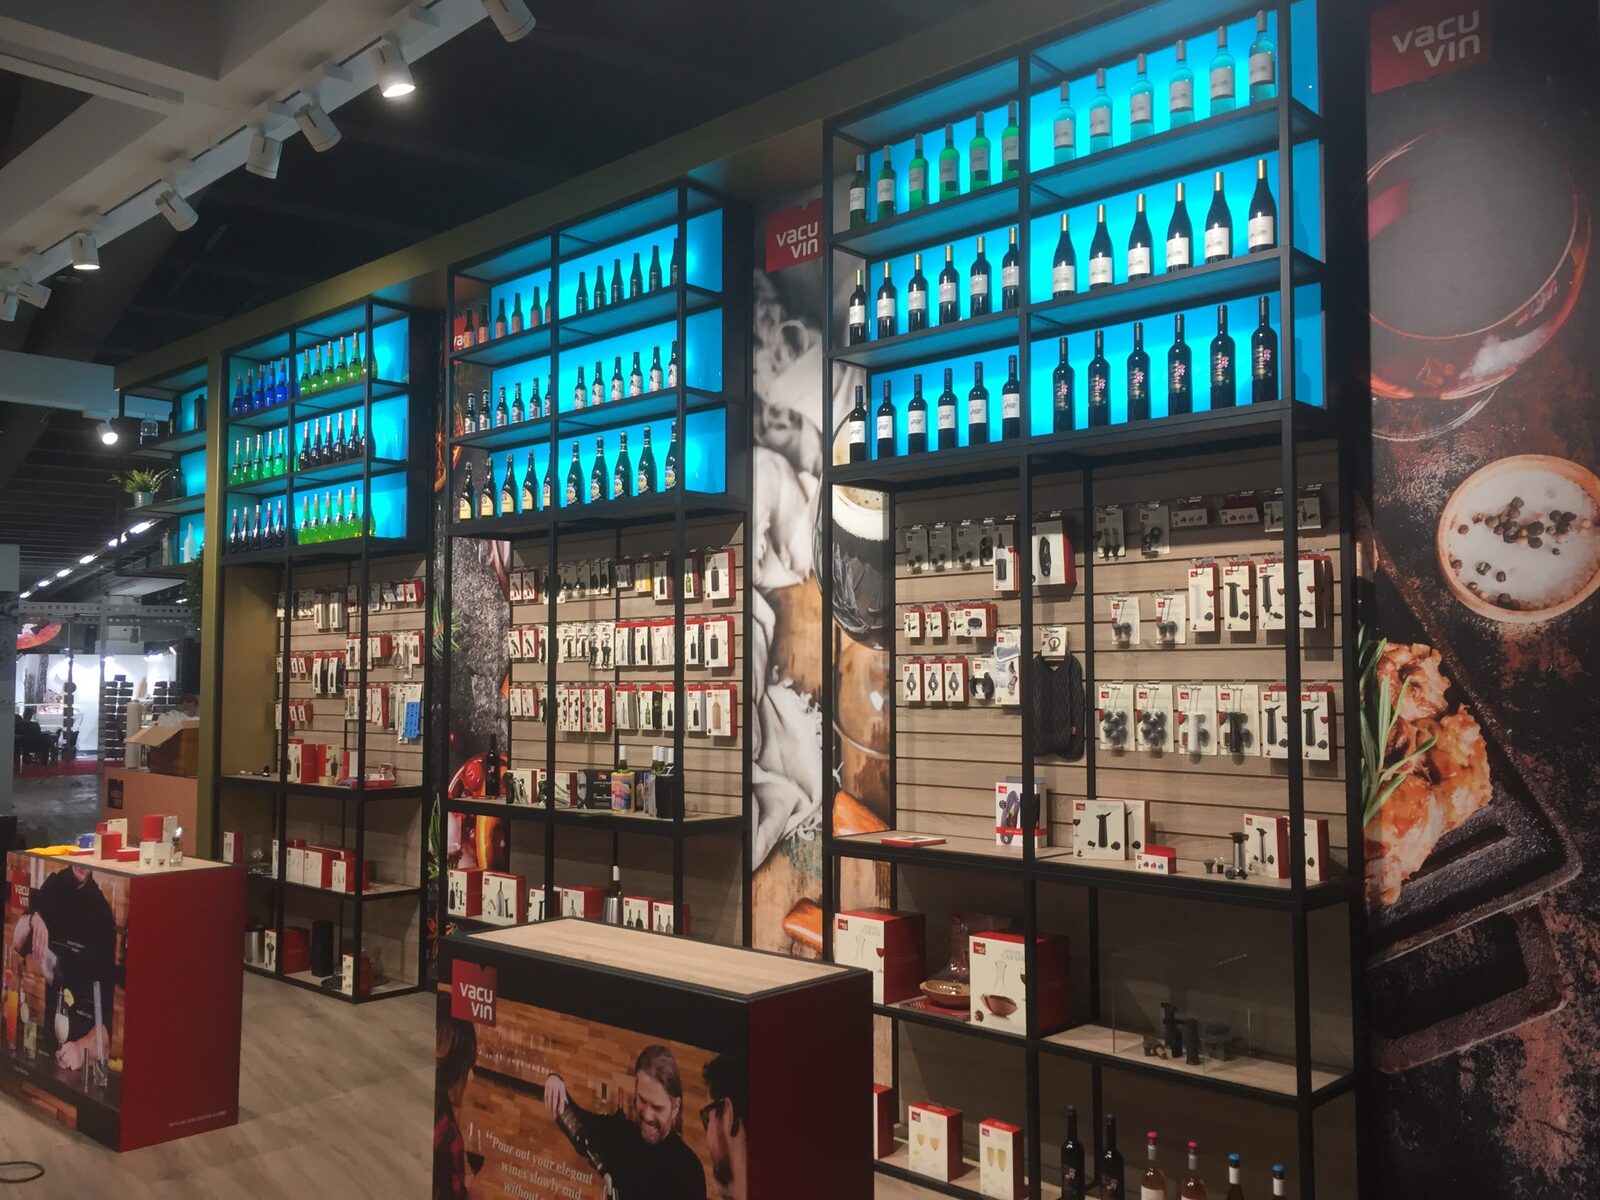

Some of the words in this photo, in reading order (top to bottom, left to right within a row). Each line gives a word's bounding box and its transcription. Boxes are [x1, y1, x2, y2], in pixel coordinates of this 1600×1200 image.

[1392, 10, 1479, 53] vacu
[1424, 34, 1480, 67] vin
[776, 221, 818, 247] vacu
[791, 238, 818, 258] vin
[460, 982, 493, 1003] vacu
[471, 1001, 492, 1021] vin
[501, 1161, 528, 1178] wines
[529, 1171, 559, 1194] slowly
[562, 1185, 582, 1200] and
[515, 1149, 530, 1161] out
[531, 1154, 554, 1169] your
[556, 1161, 593, 1185] elegant
